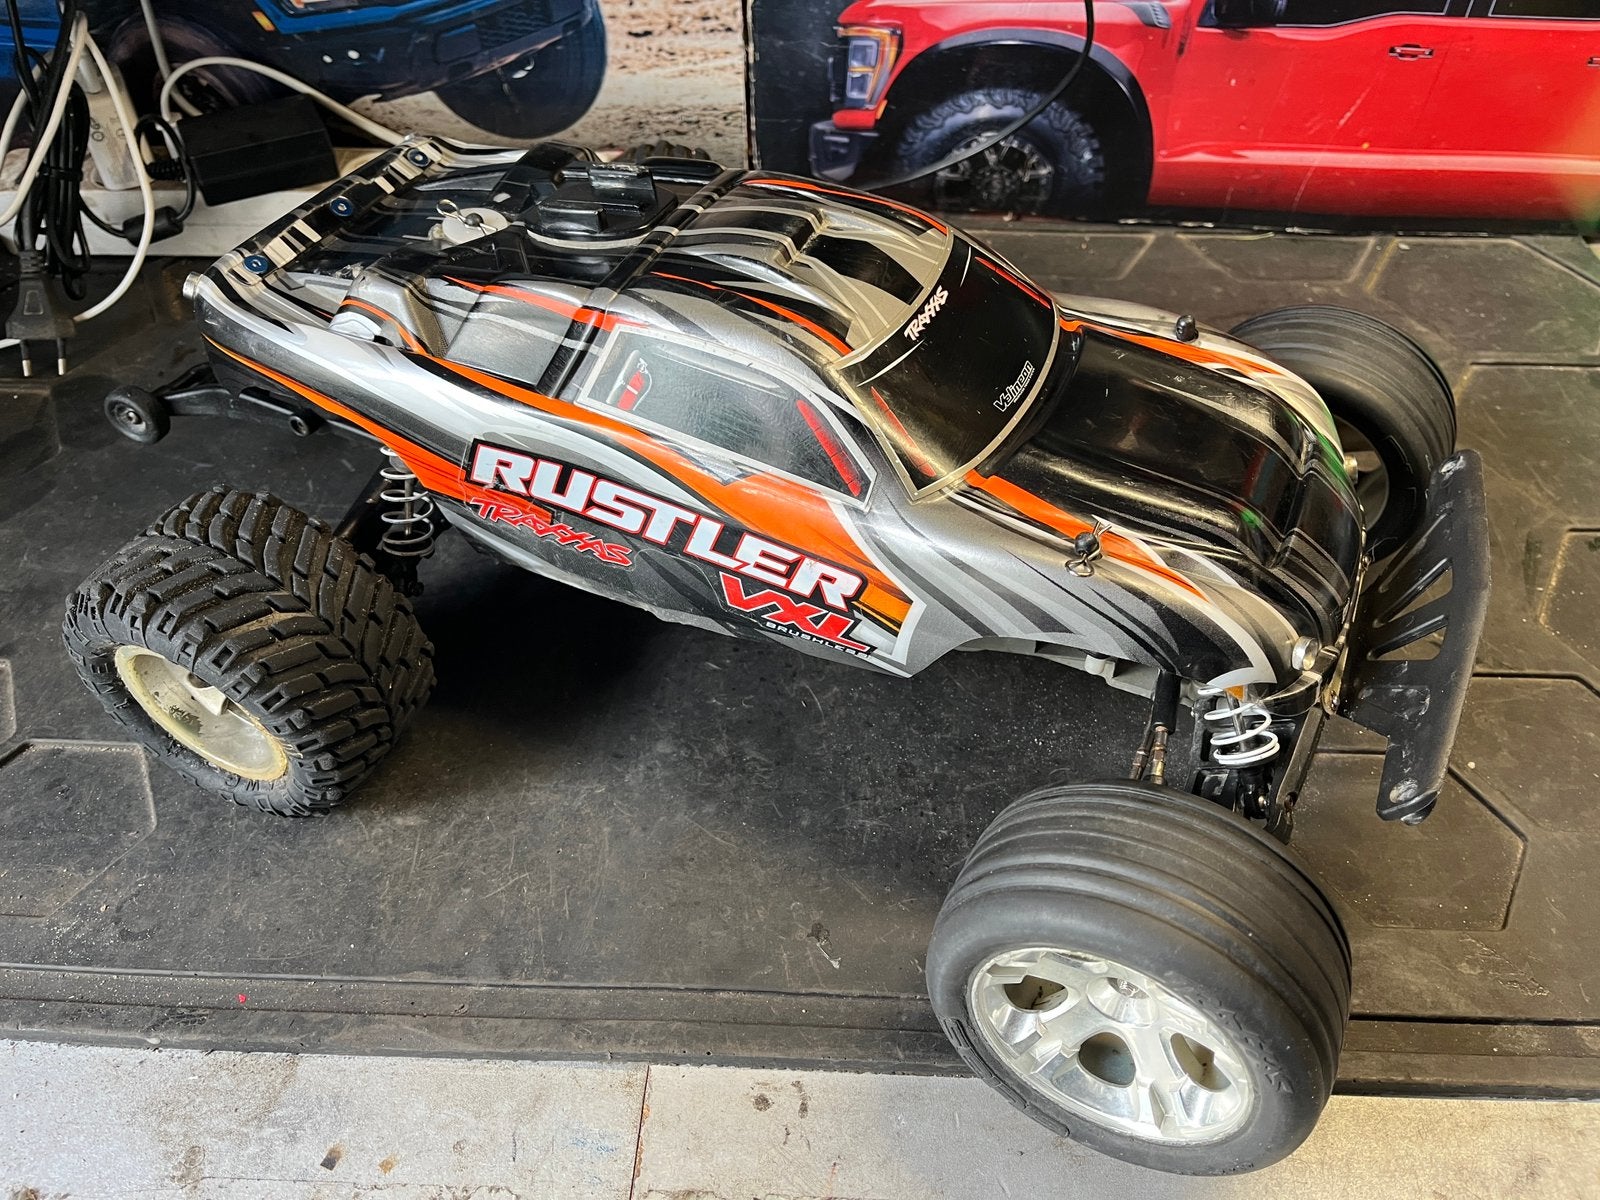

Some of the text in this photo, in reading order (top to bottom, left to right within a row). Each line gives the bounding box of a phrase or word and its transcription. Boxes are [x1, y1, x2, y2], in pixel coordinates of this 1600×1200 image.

[904, 286, 949, 341] TRAXXAS
[993, 360, 1034, 412] Velineon
[468, 497, 634, 567] TRAXXAS
[470, 443, 864, 610] RUSTLER
[719, 571, 871, 652] VXL
